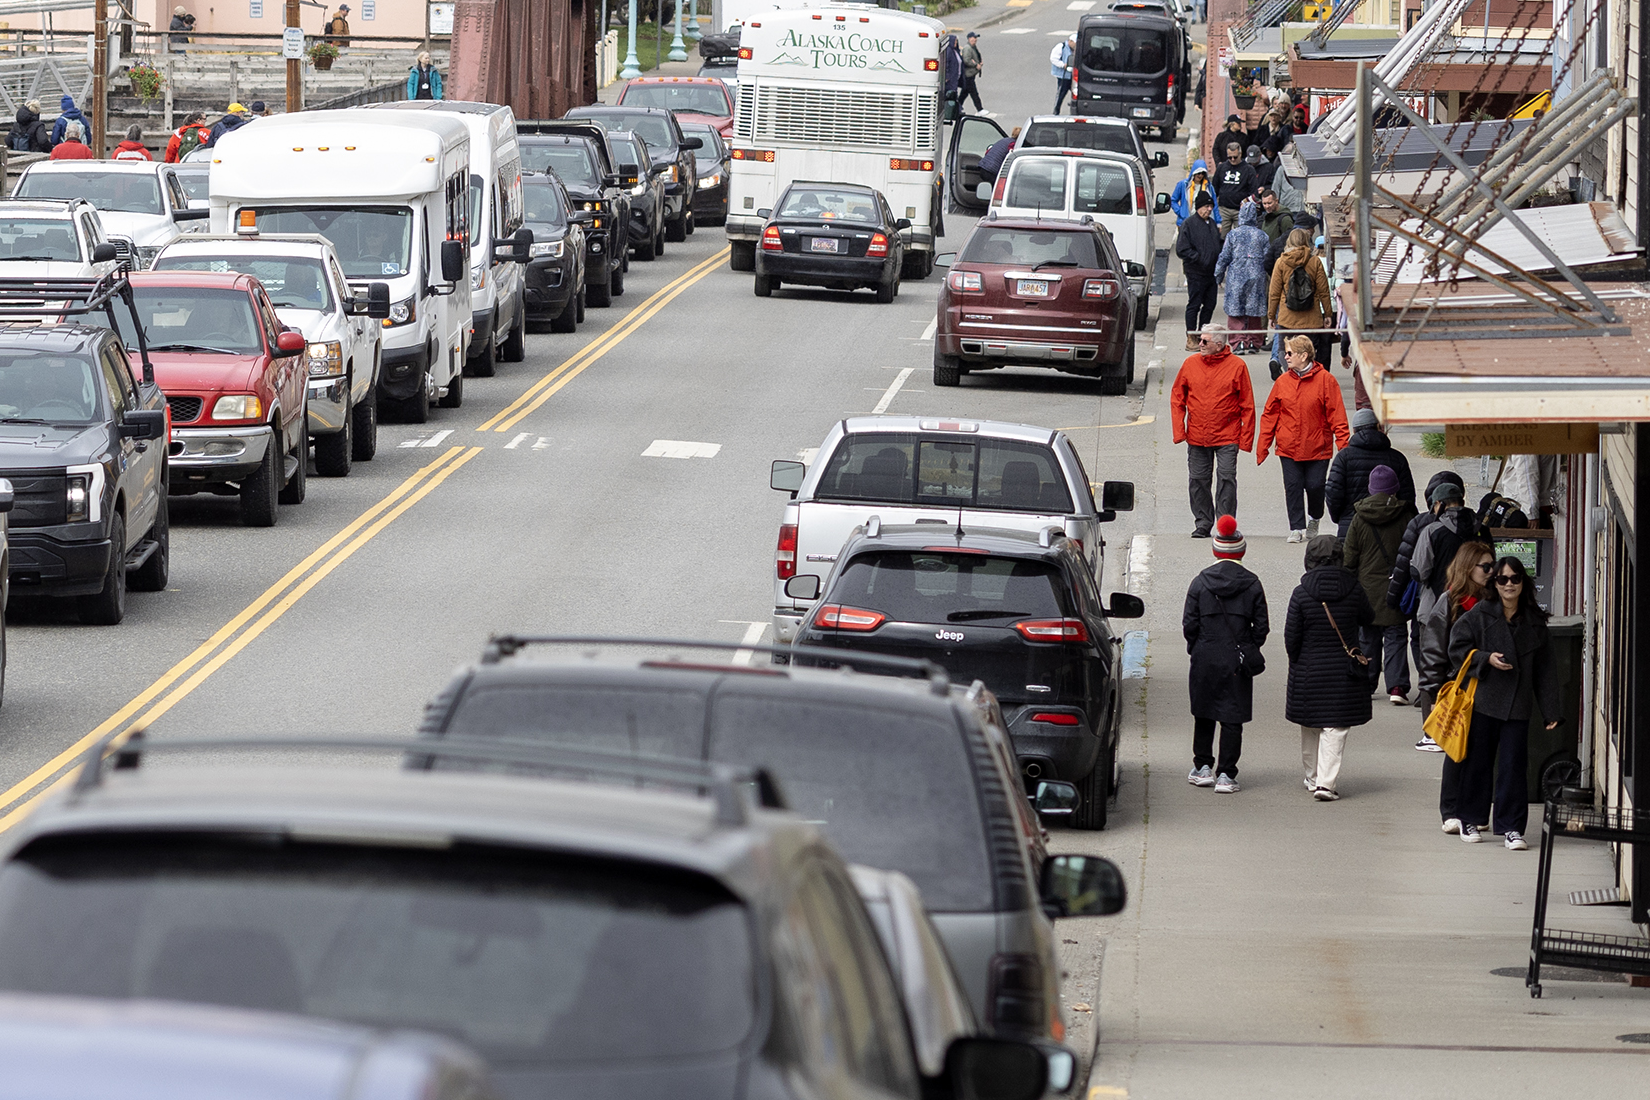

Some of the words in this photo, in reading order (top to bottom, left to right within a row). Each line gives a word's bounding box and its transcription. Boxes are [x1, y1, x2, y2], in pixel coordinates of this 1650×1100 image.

[776, 29, 846, 50] ALASKA
[848, 33, 904, 53] COACH
[810, 49, 867, 69] TOURS
[1456, 435, 1477, 448] BY
[1479, 434, 1534, 447] AMBER
[935, 629, 965, 642] Jeep
